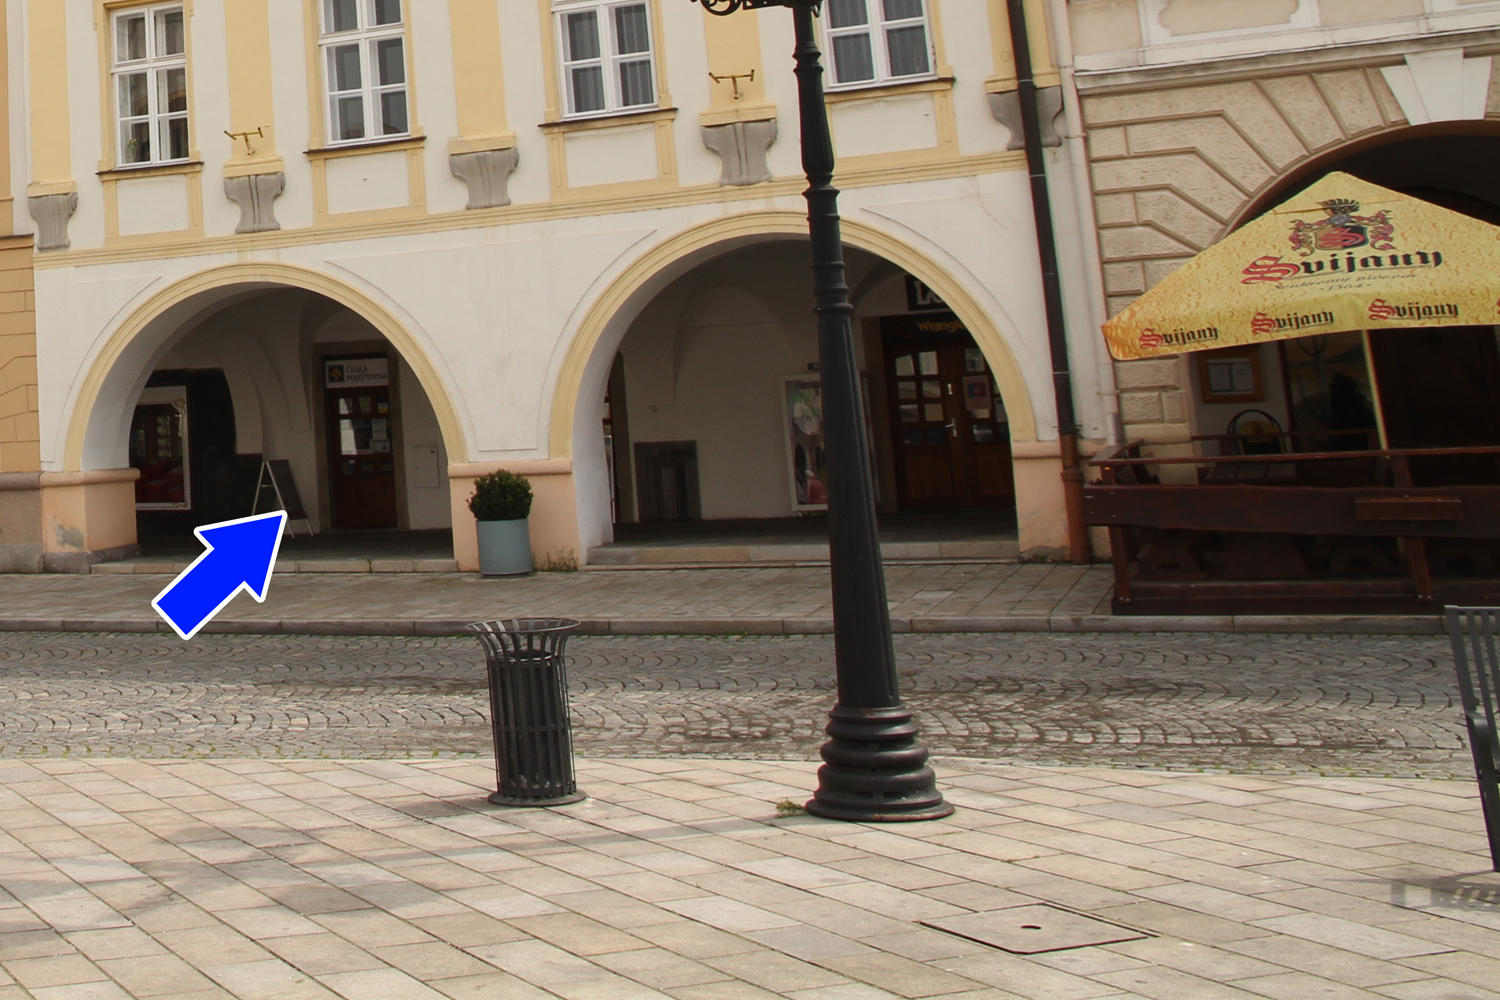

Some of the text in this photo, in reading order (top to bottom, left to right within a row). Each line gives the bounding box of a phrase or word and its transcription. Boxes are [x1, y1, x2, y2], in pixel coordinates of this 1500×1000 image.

[1241, 251, 1443, 285] Svijany
[1368, 298, 1459, 320] Svijany
[1251, 311, 1335, 334] Svijany
[1139, 327, 1219, 349] Svijany
